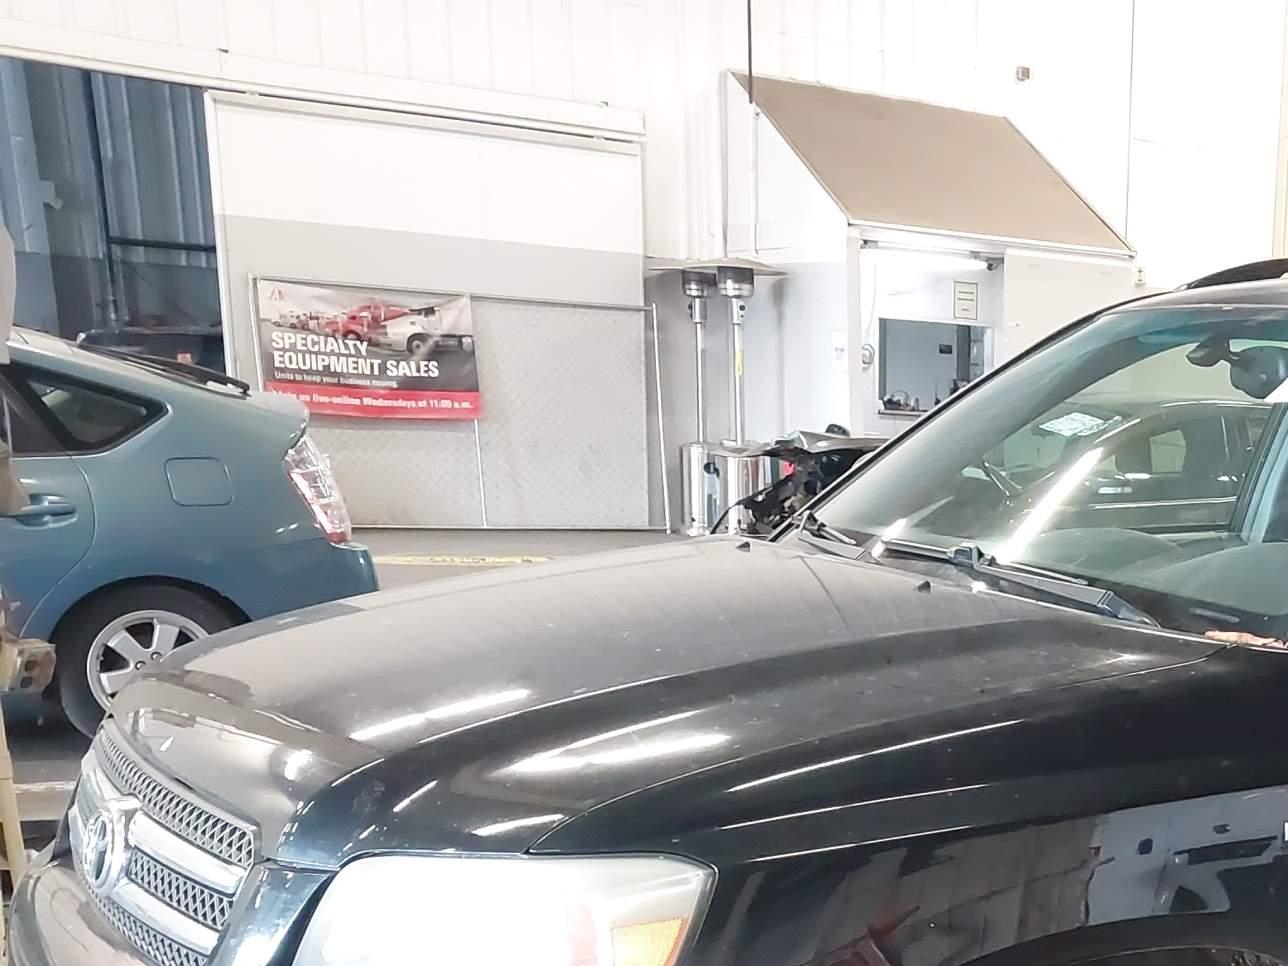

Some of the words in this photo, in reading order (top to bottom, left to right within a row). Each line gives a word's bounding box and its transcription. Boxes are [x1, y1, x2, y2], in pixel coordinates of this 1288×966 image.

[272, 331, 368, 356] SPECIALTY
[273, 351, 381, 377] EQUIPMENT
[386, 360, 440, 377] SALES
